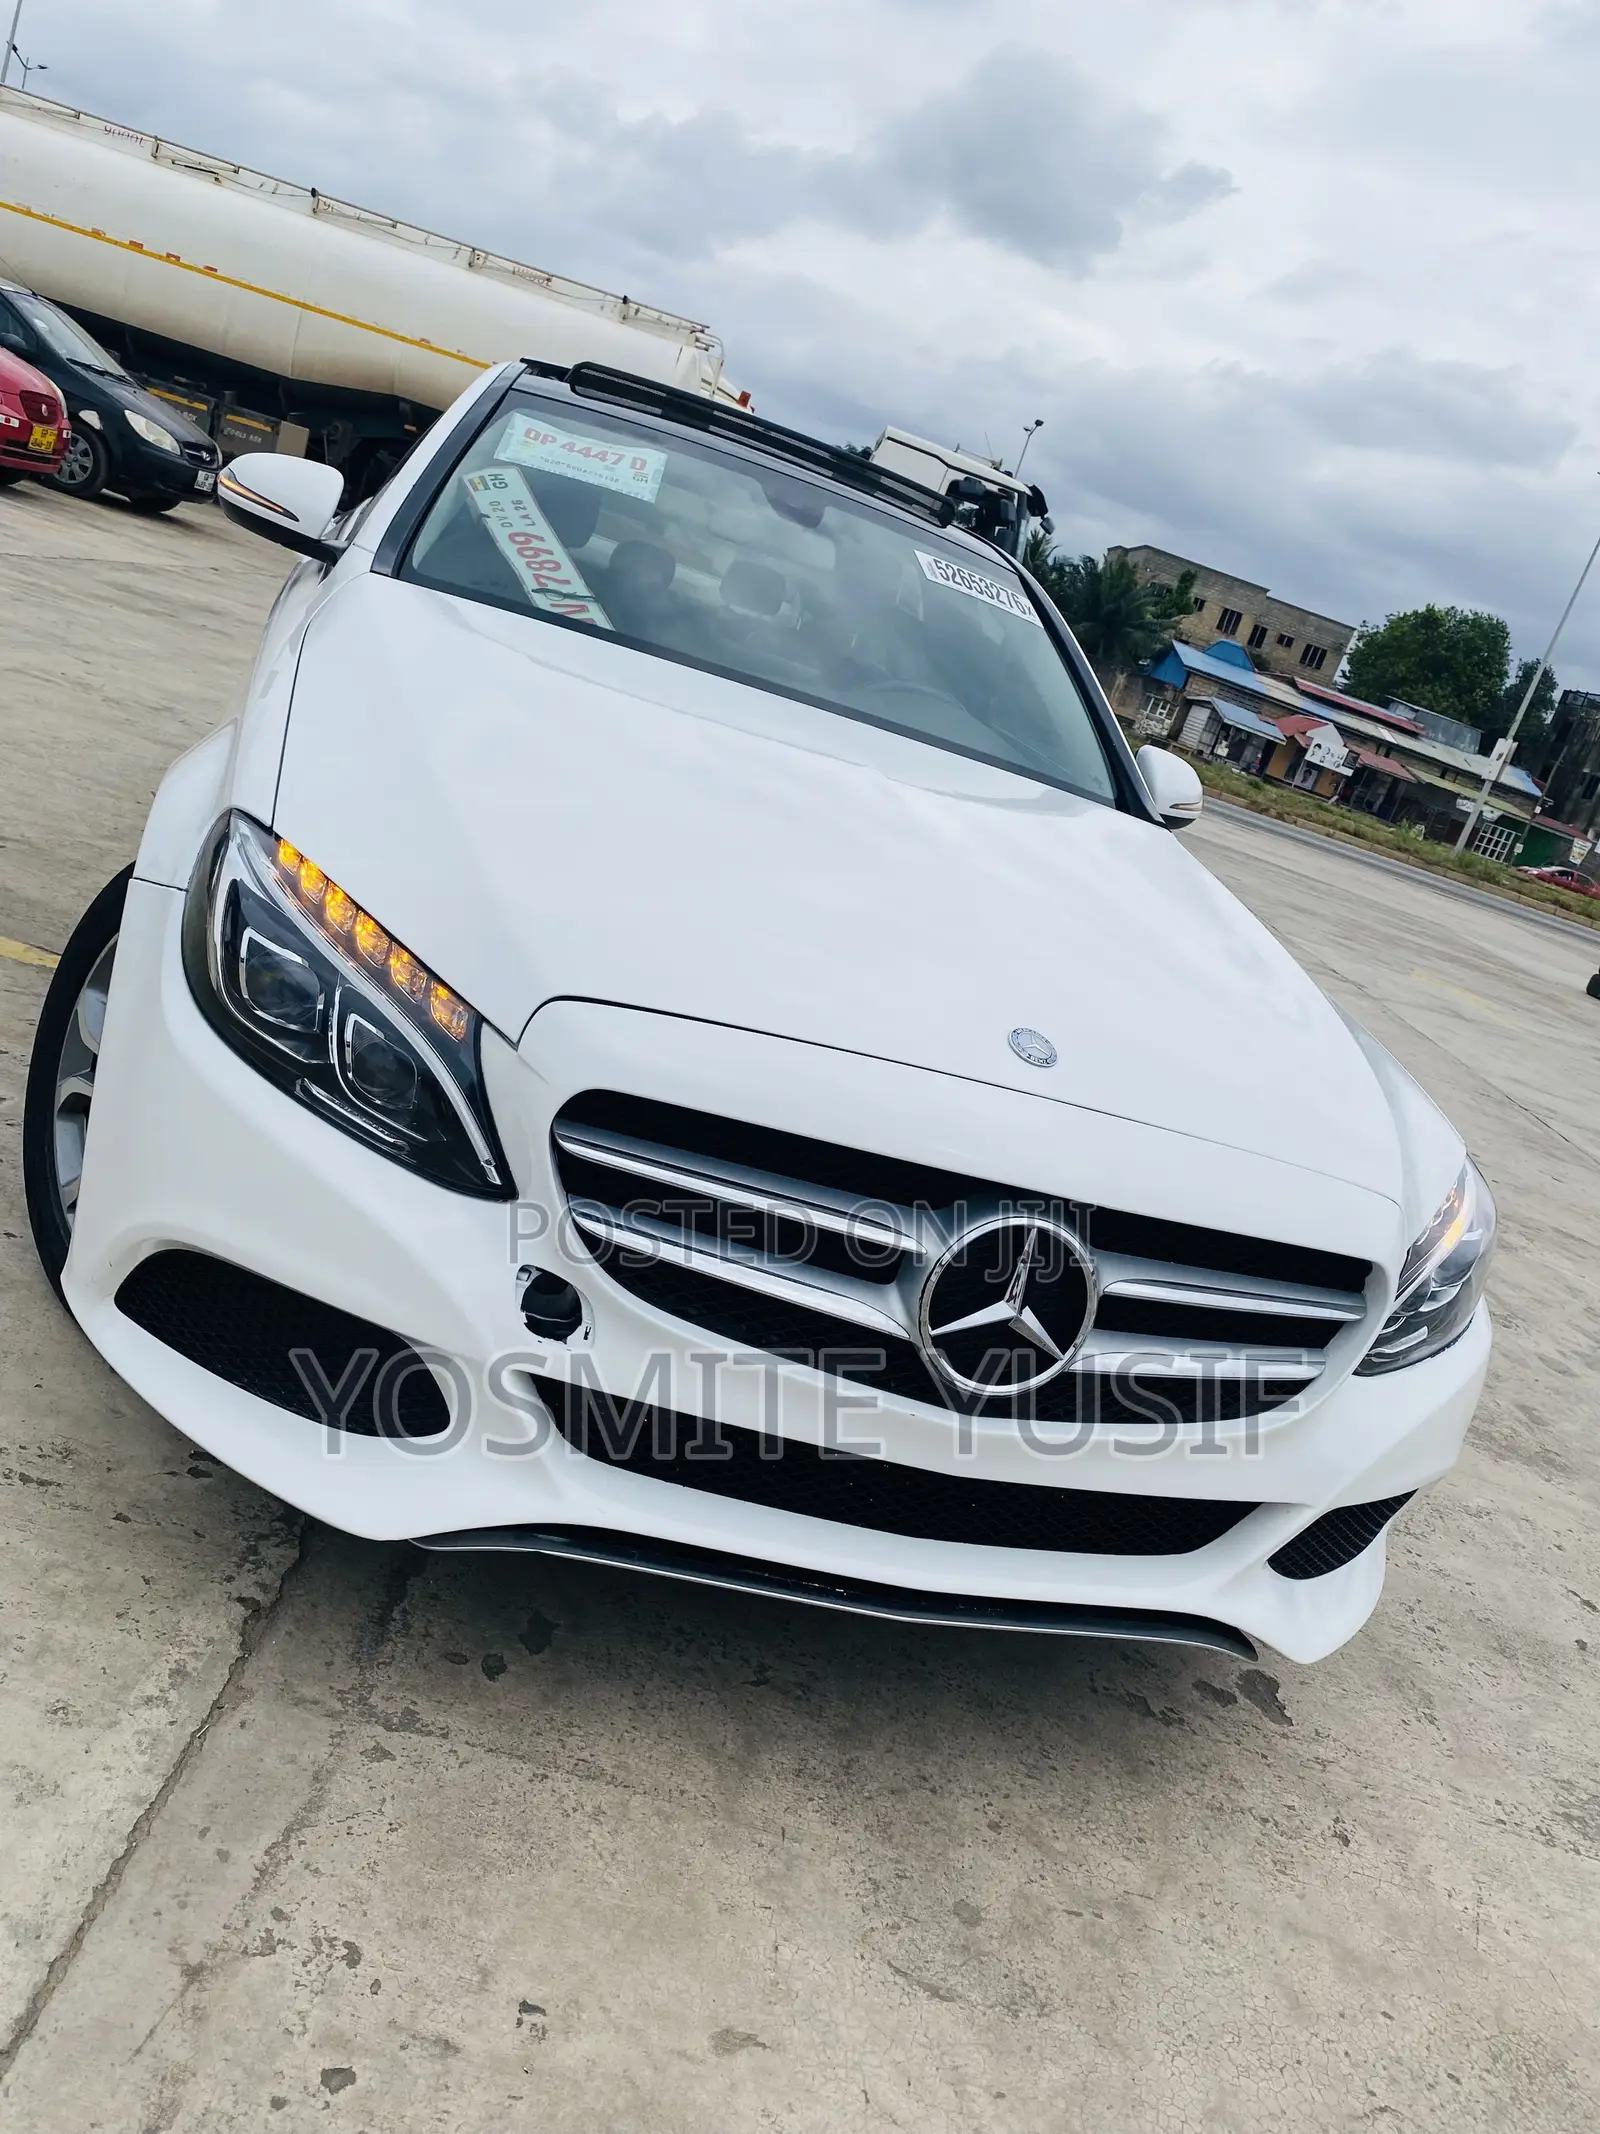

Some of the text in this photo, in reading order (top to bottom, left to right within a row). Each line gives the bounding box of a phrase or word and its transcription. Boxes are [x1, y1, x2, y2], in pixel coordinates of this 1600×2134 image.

[523, 426, 558, 445] DP
[559, 441, 626, 466] 4447
[629, 456, 648, 472] D
[488, 473, 509, 490] GH
[489, 500, 514, 529] DV 20
[511, 499, 537, 527] LA 26
[508, 531, 599, 625] V 7899
[932, 558, 1027, 615] 52653276
